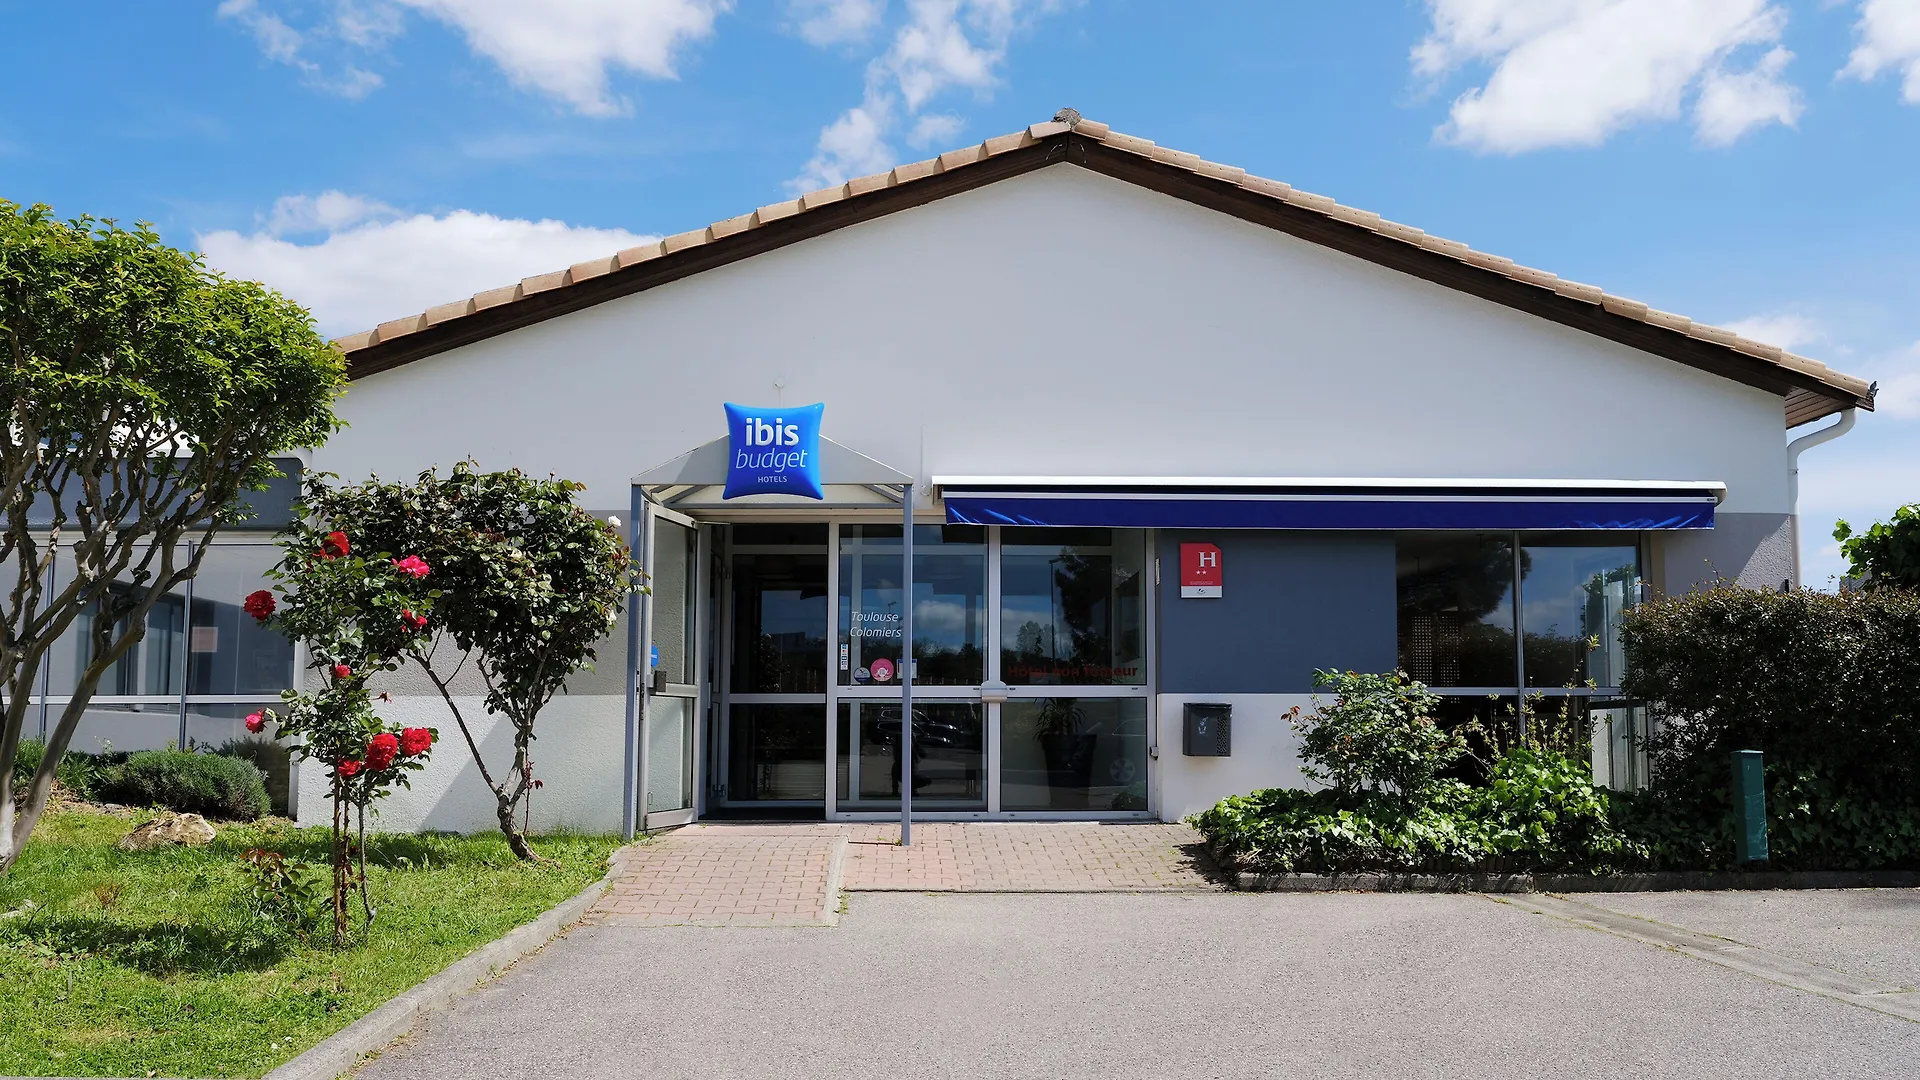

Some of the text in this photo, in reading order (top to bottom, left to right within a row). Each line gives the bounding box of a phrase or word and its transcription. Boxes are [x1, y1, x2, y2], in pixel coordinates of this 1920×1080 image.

[745, 417, 800, 446] ibis
[735, 448, 808, 473] budget
[757, 475, 788, 483] HOTELS
[1198, 551, 1217, 568] H
[851, 611, 899, 622] Toulouse
[849, 626, 902, 638] Colomiers
